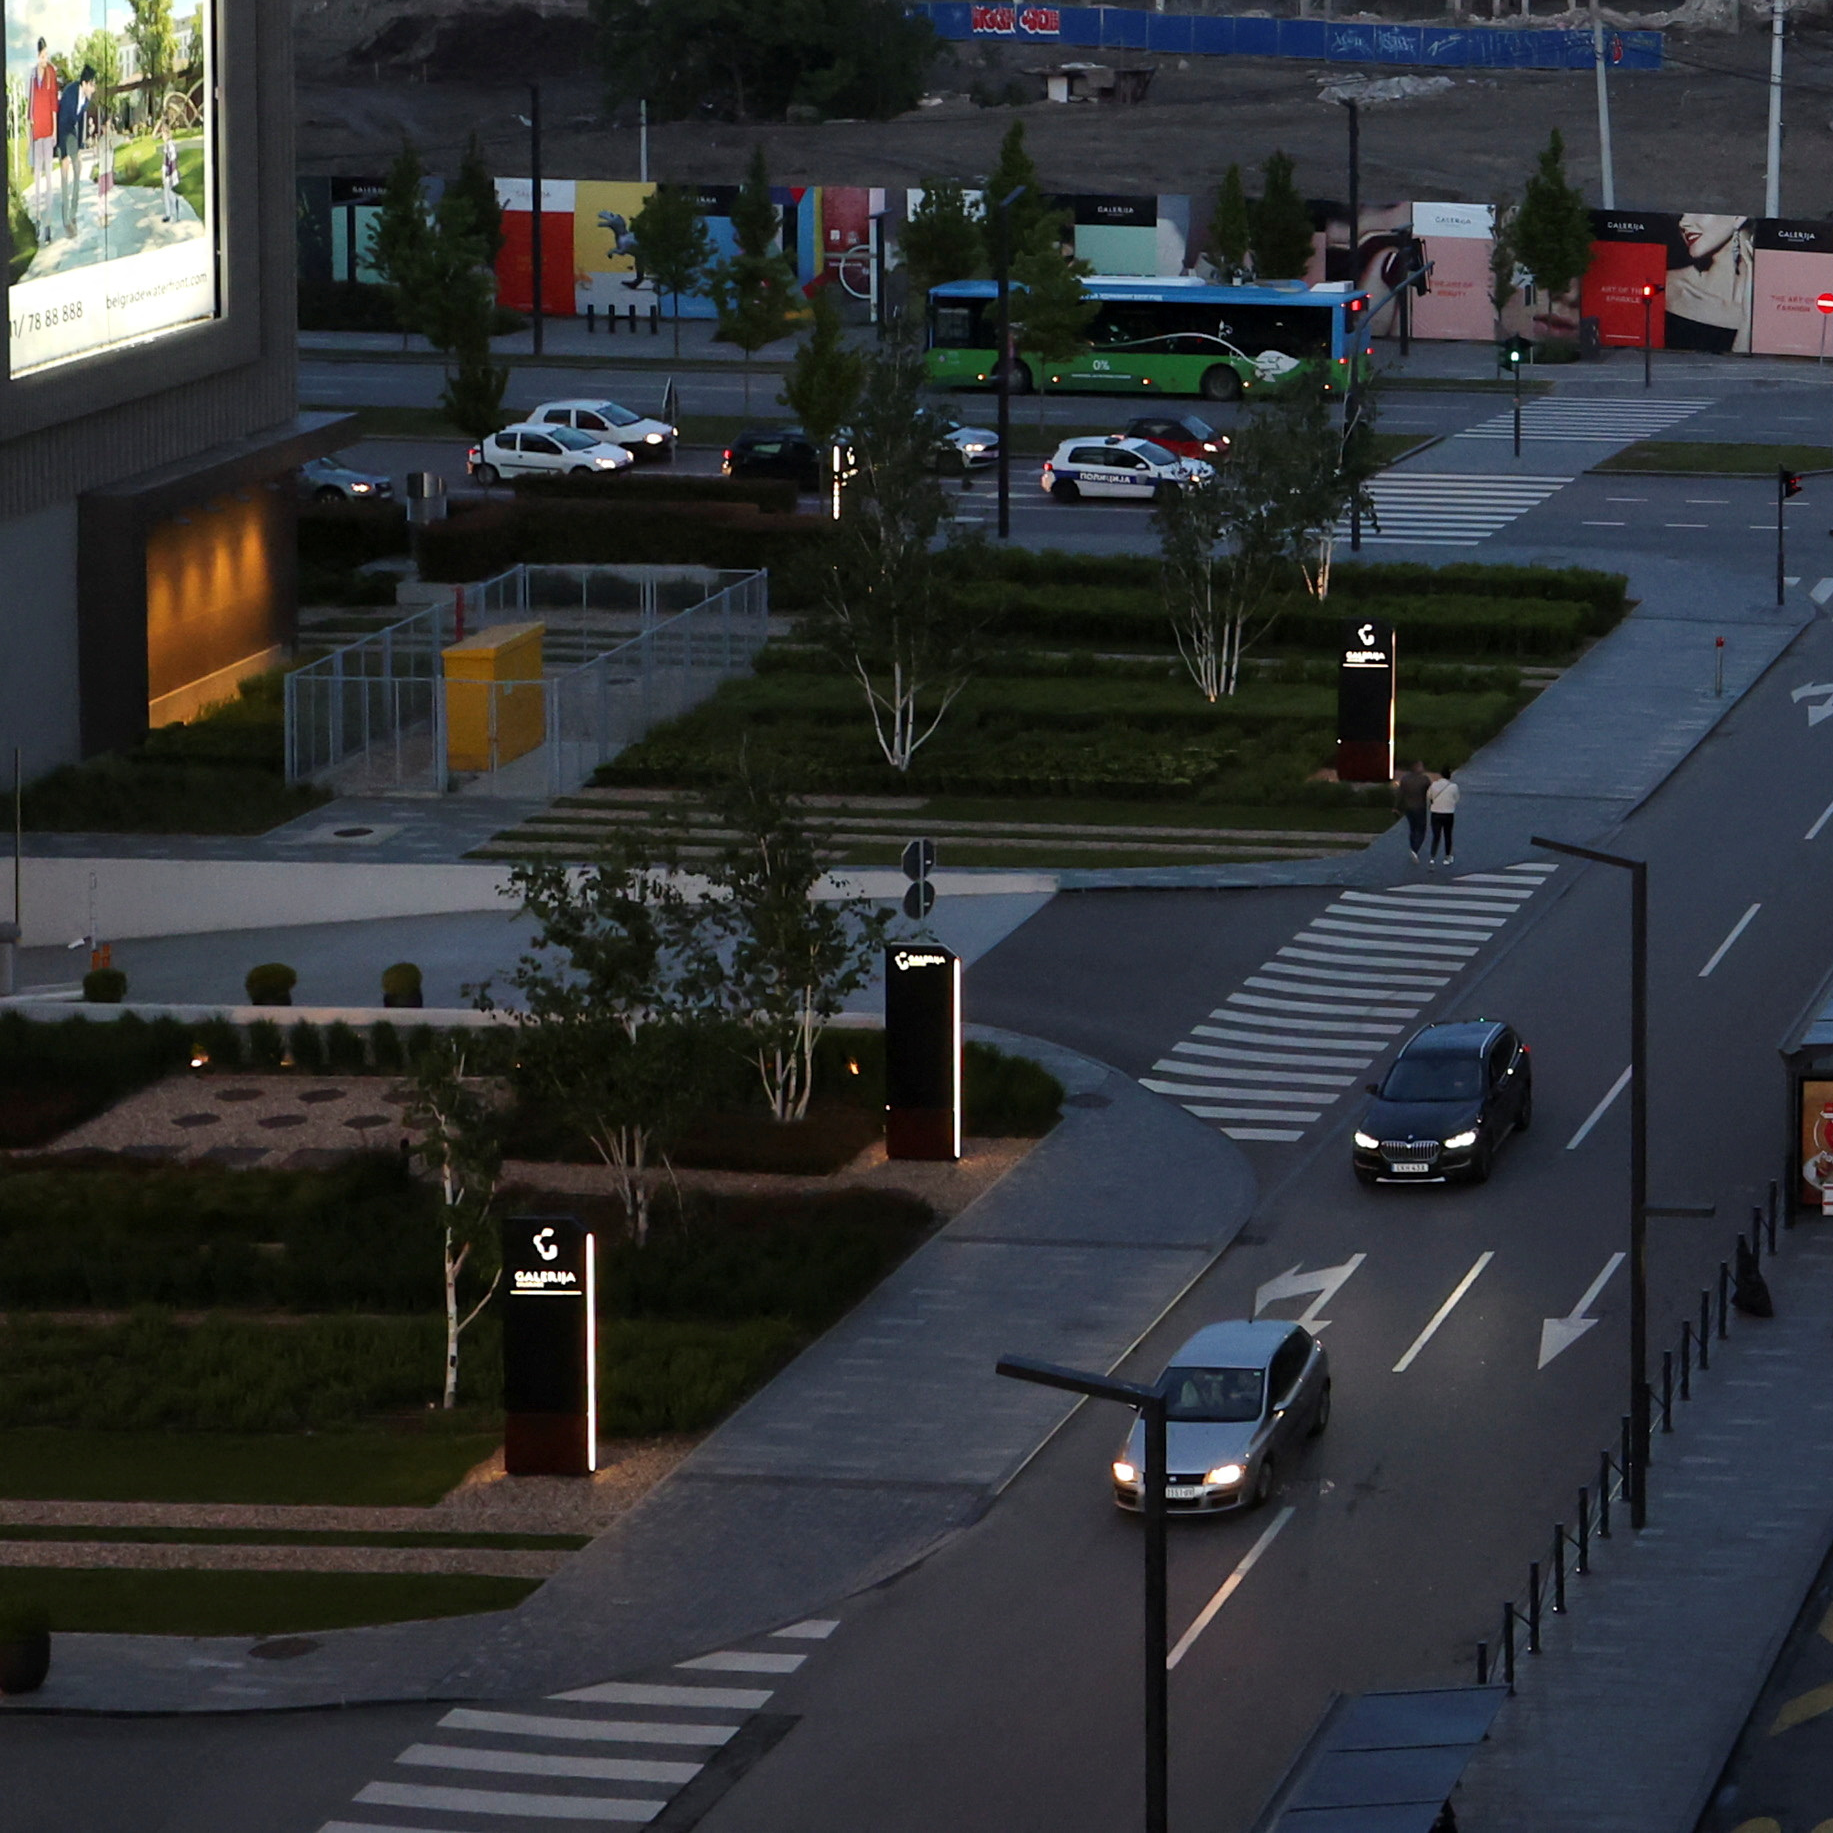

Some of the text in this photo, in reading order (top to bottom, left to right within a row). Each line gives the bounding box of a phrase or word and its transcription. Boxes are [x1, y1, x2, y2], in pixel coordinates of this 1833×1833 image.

[1097, 205, 1135, 215] GALERIJA
[1435, 216, 1472, 225] GALERIJA
[1607, 221, 1645, 232] GALERIJA
[1777, 230, 1816, 241] GALERIJA
[44, 307, 59, 327] 88
[62, 301, 83, 323] 888
[1092, 360, 1110, 371] 0%
[1080, 472, 1132, 484] ПОЛИЦИЈА
[514, 1270, 577, 1286] GALERIJA
